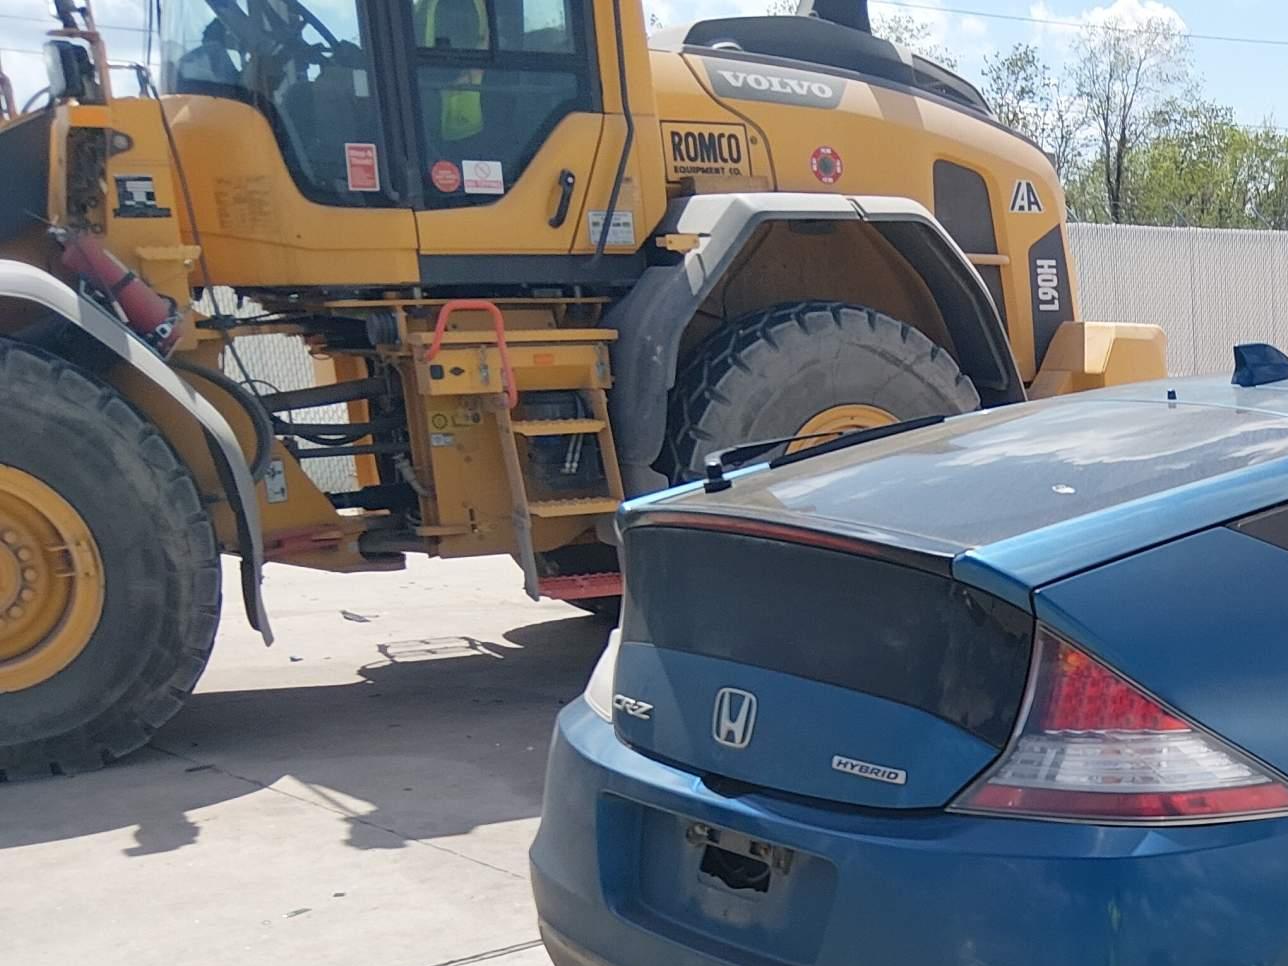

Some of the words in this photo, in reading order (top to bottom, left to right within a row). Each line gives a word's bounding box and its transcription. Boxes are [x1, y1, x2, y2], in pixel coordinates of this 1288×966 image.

[717, 70, 833, 98] VOLVO
[671, 131, 741, 164] ROMCO
[674, 165, 725, 175] EQUIPMENT
[1036, 259, 1060, 311] L90H
[836, 759, 899, 780] HYBRID
